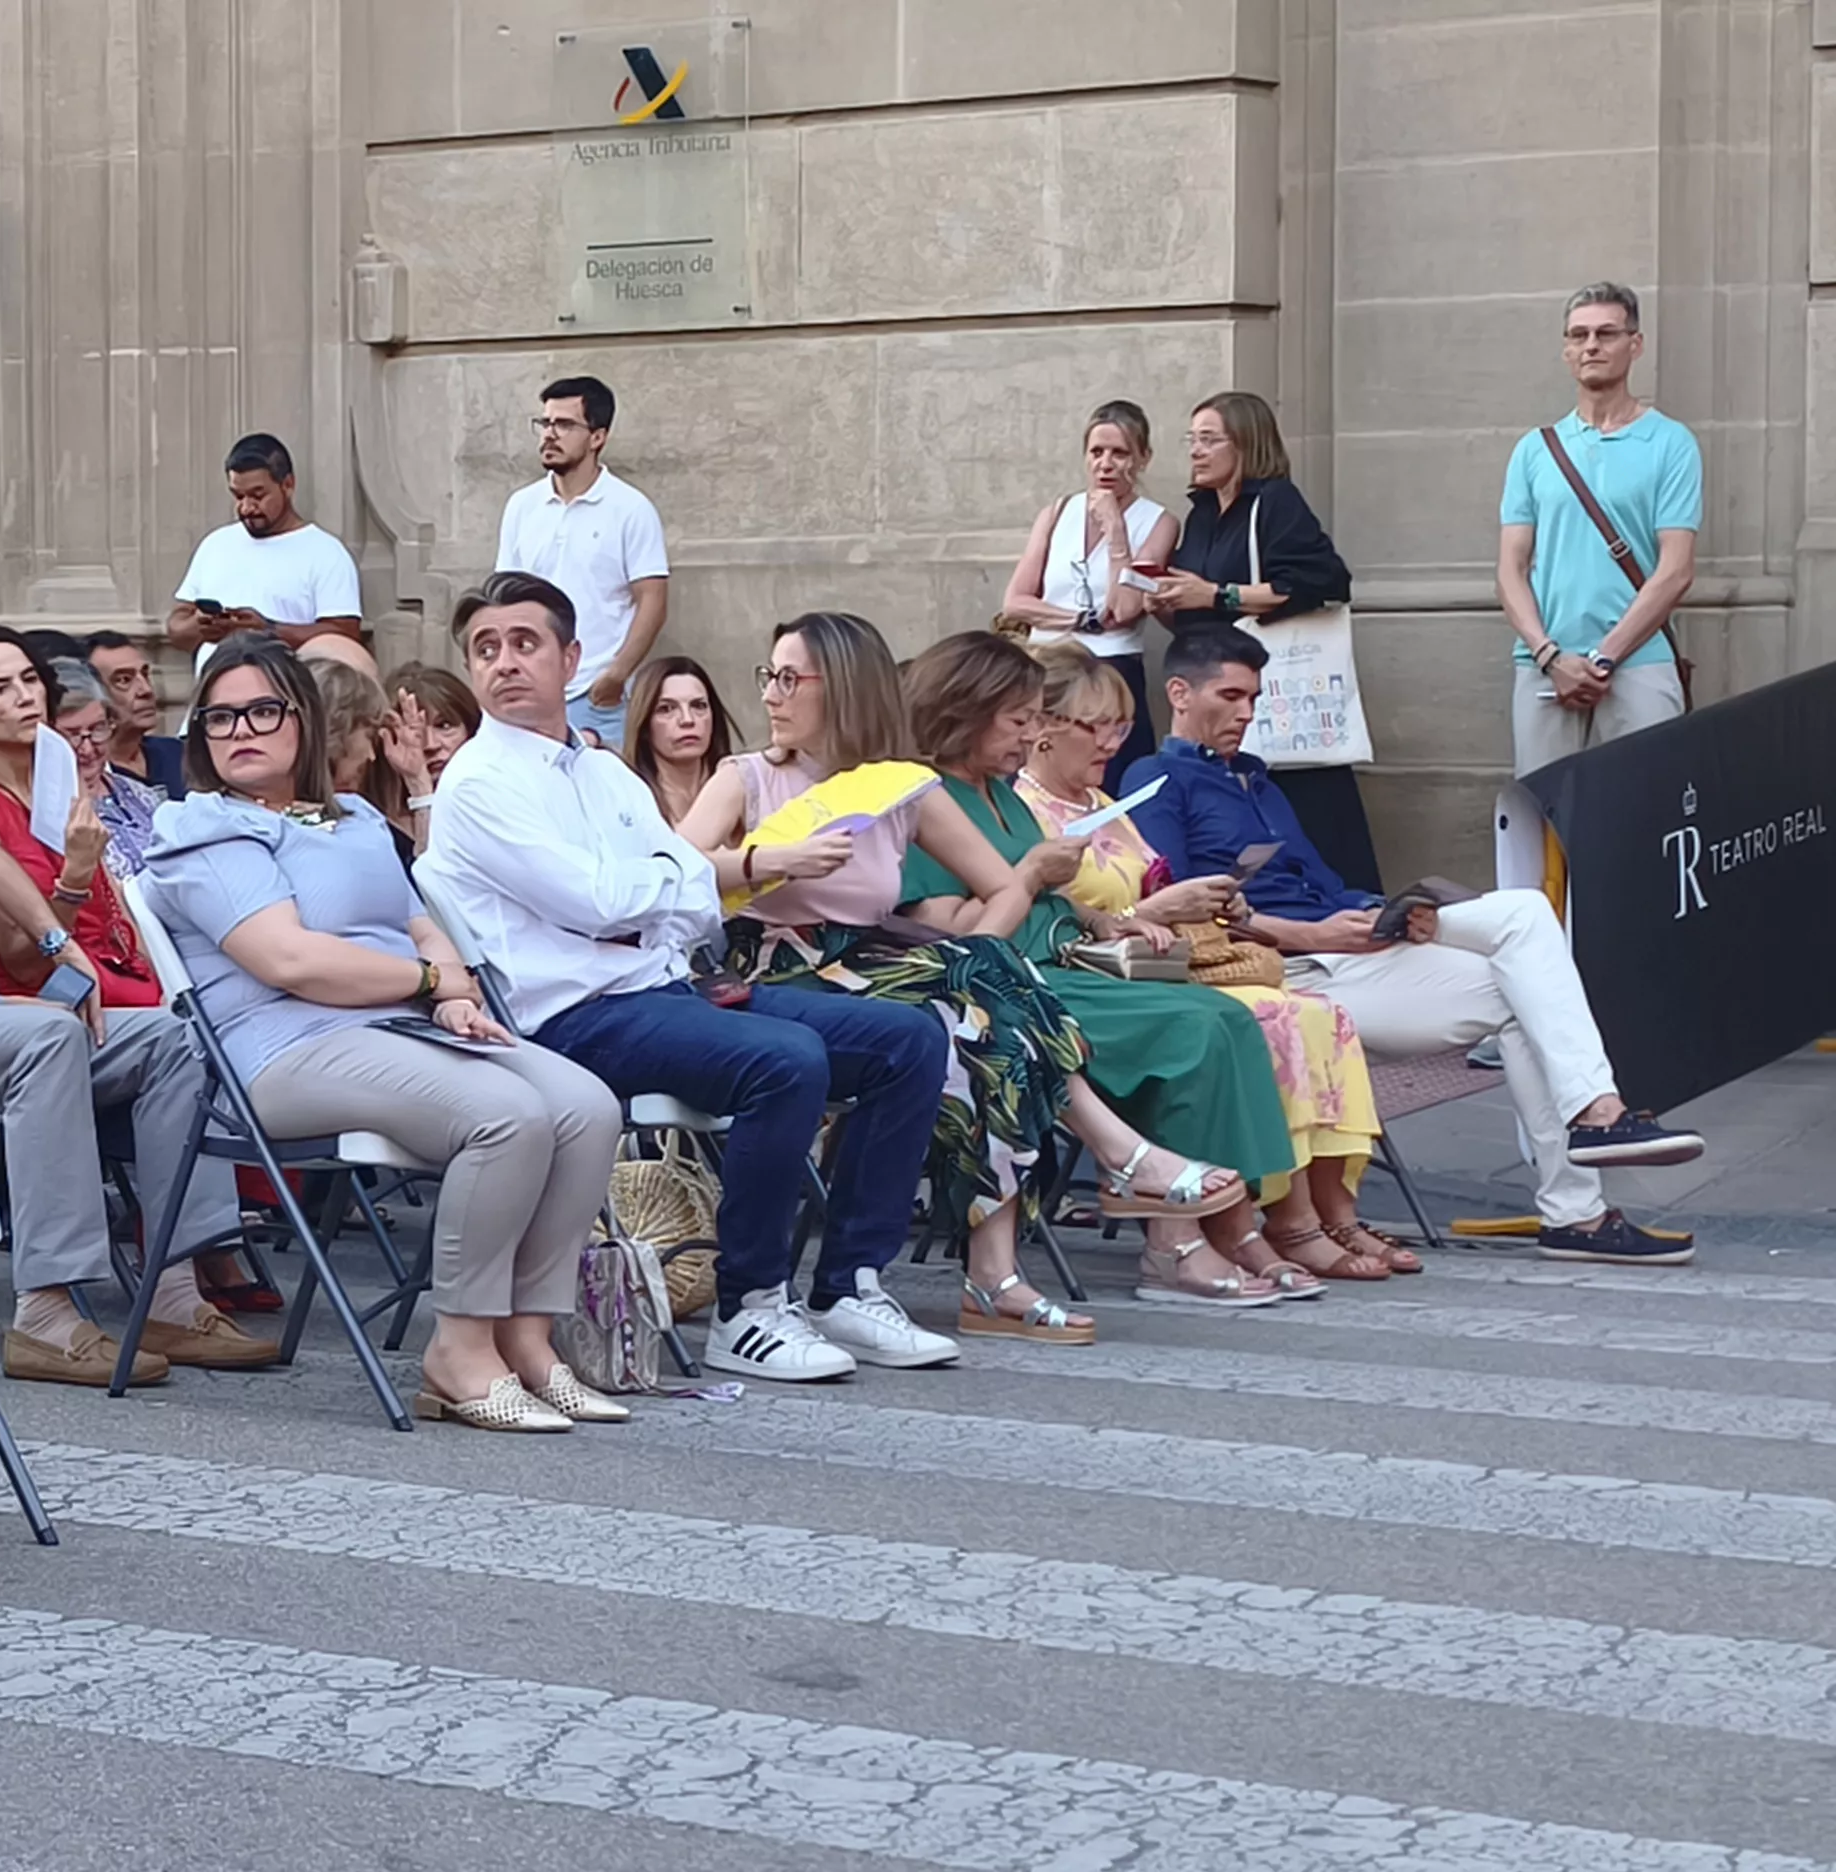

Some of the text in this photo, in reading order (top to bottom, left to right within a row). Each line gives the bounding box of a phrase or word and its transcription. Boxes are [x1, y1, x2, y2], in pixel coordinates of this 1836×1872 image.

[570, 134, 731, 166] Agencia Tributaria
[689, 254, 714, 274] de
[615, 281, 684, 300] Huesca
[1709, 804, 1828, 876] TEATRO REAL
